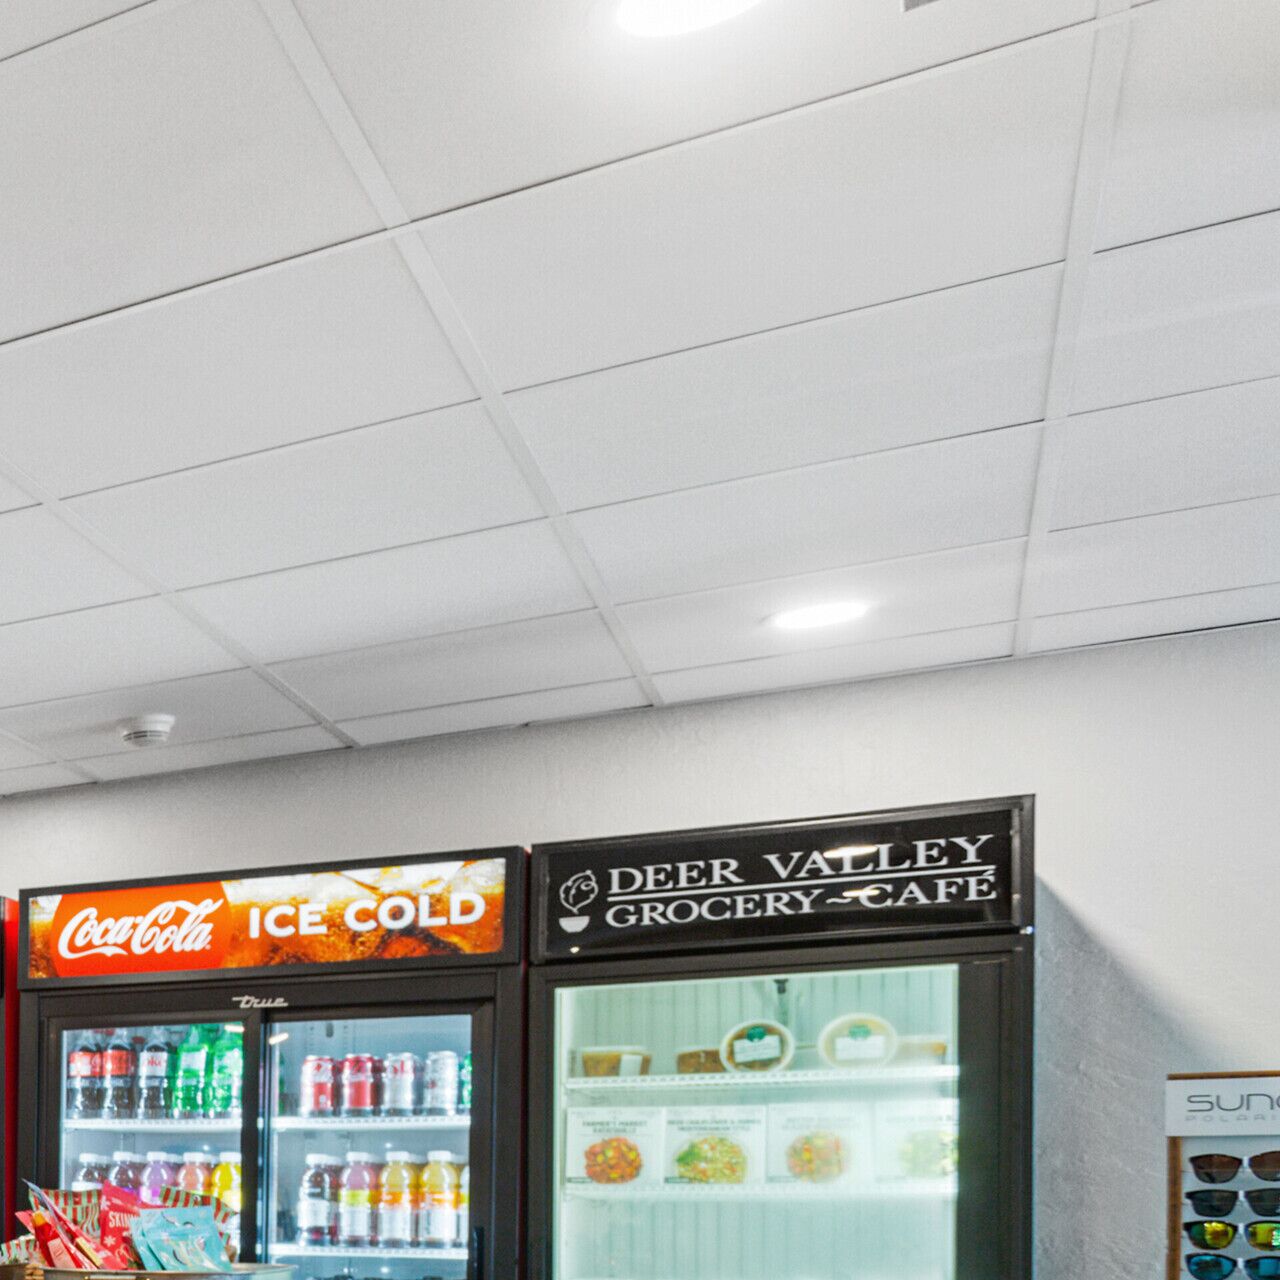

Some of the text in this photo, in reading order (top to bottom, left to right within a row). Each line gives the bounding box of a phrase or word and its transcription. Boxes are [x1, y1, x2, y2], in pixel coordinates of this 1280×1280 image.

[606, 834, 995, 896] DEER VALLEY
[57, 890, 487, 960] Coca-Cola ICE COLD
